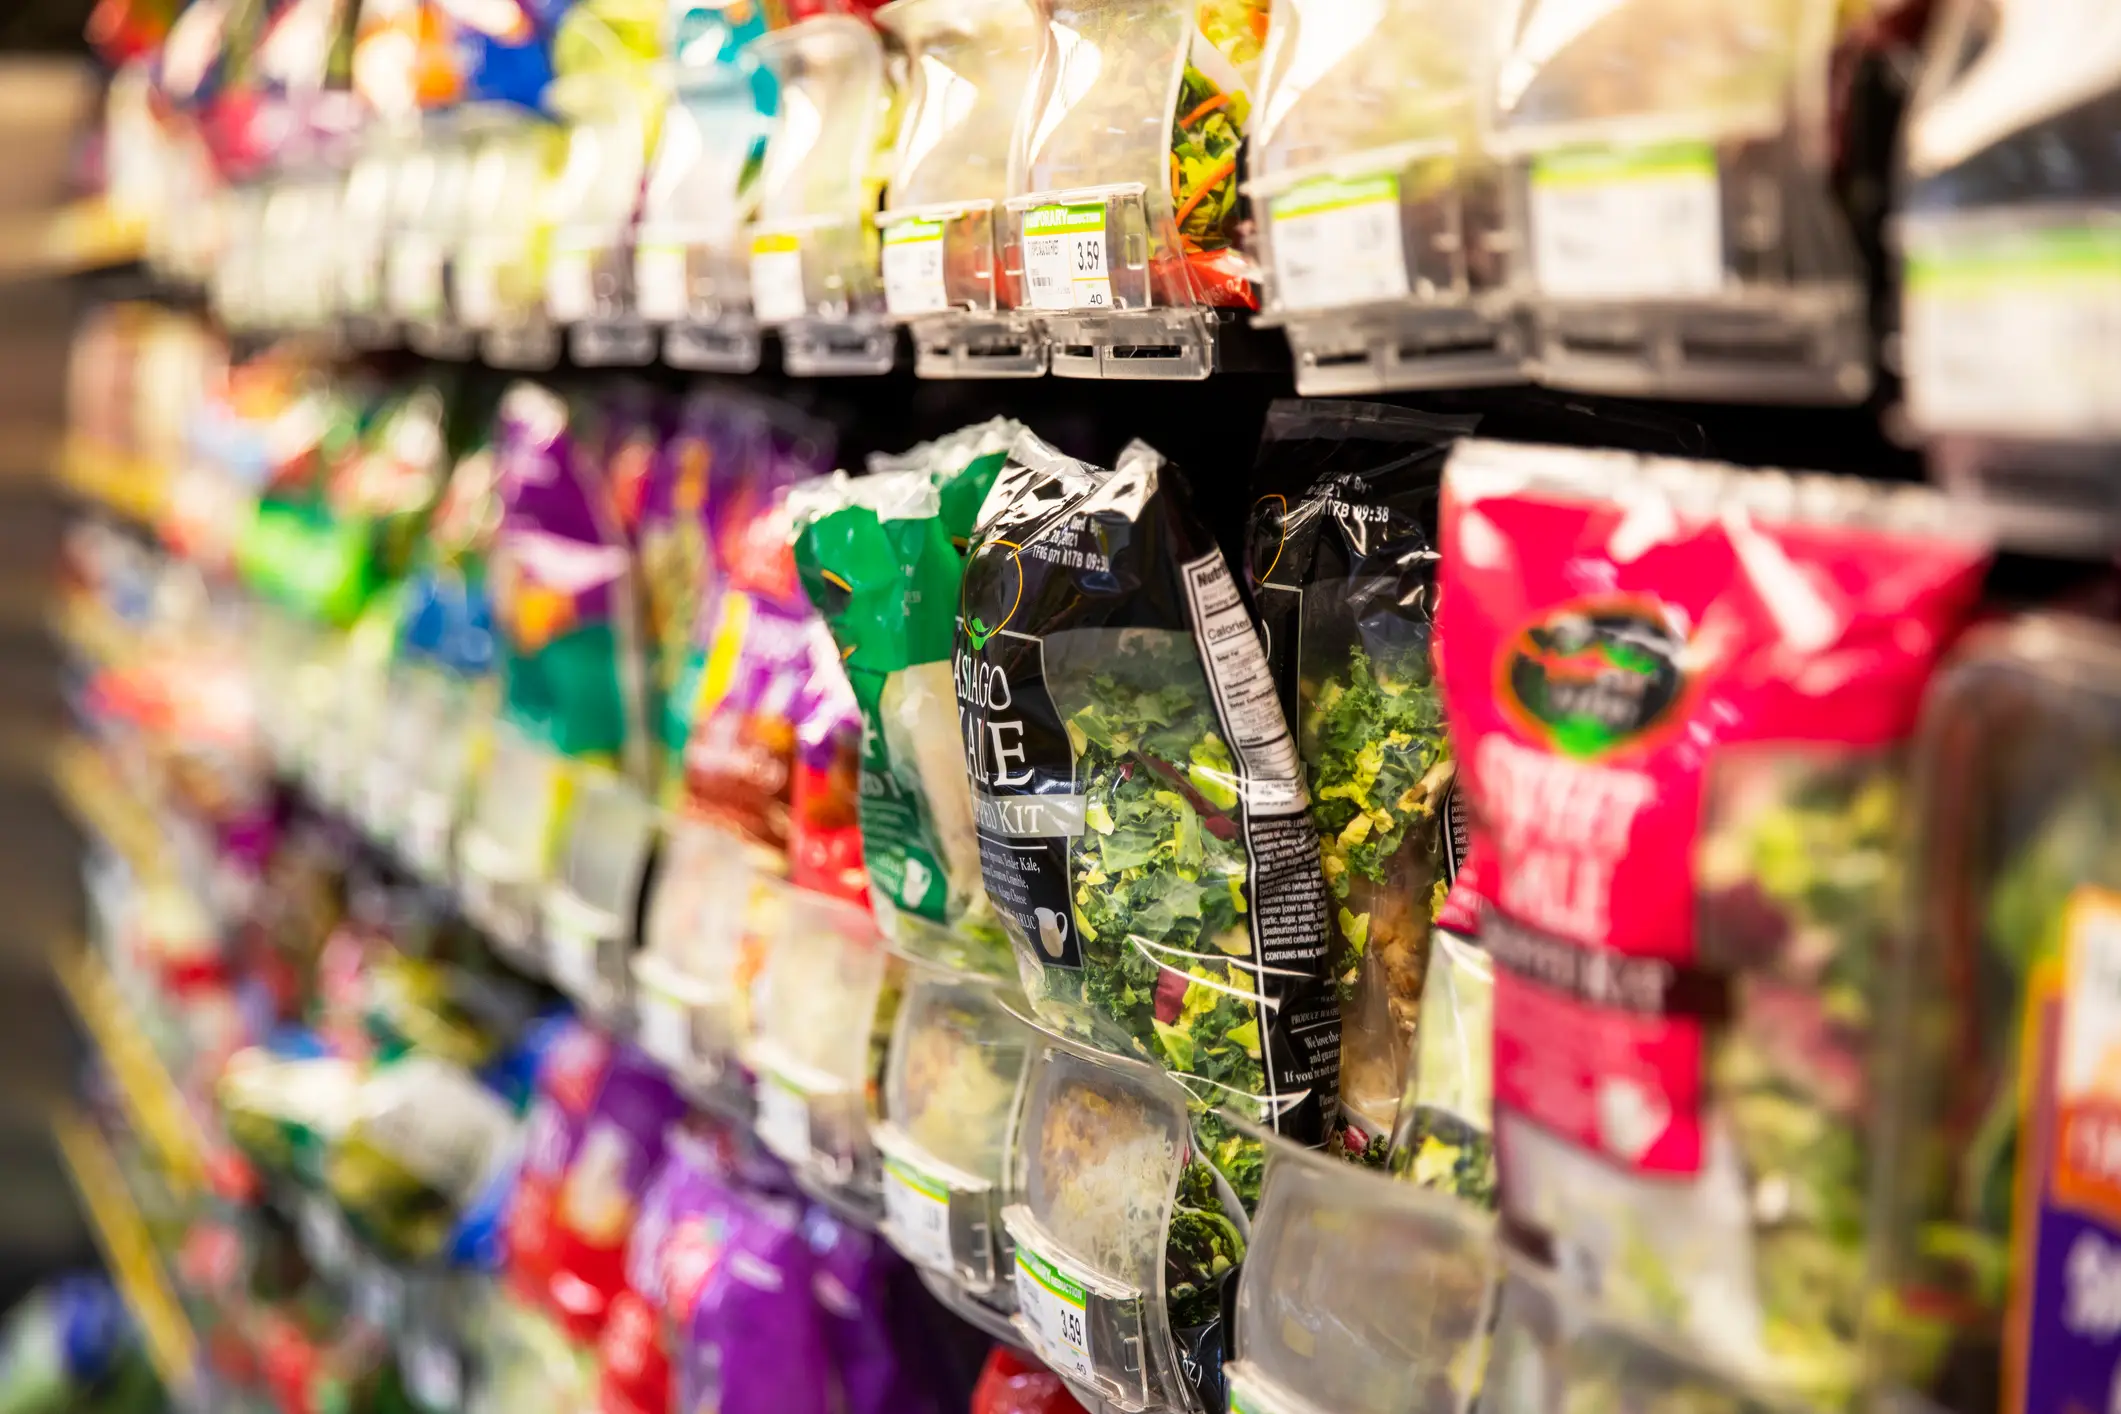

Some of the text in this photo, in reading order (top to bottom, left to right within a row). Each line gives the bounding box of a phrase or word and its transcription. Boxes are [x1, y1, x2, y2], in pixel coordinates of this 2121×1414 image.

[1077, 241, 1100, 271] 3.59
[1352, 505, 1390, 523] 09:38
[953, 648, 1012, 712] ASIAGO
[998, 800, 1044, 834] KIT
[1018, 856, 1042, 874] Kale,
[1263, 935, 1293, 948] powdered
[1264, 950, 1298, 962] CONTAINS
[1297, 947, 1316, 959] MILK,
[1304, 1030, 1339, 1050] We love the
[1309, 1050, 1321, 1065] and
[1284, 1071, 1295, 1083] If
[1060, 1309, 1082, 1346] 3.59
